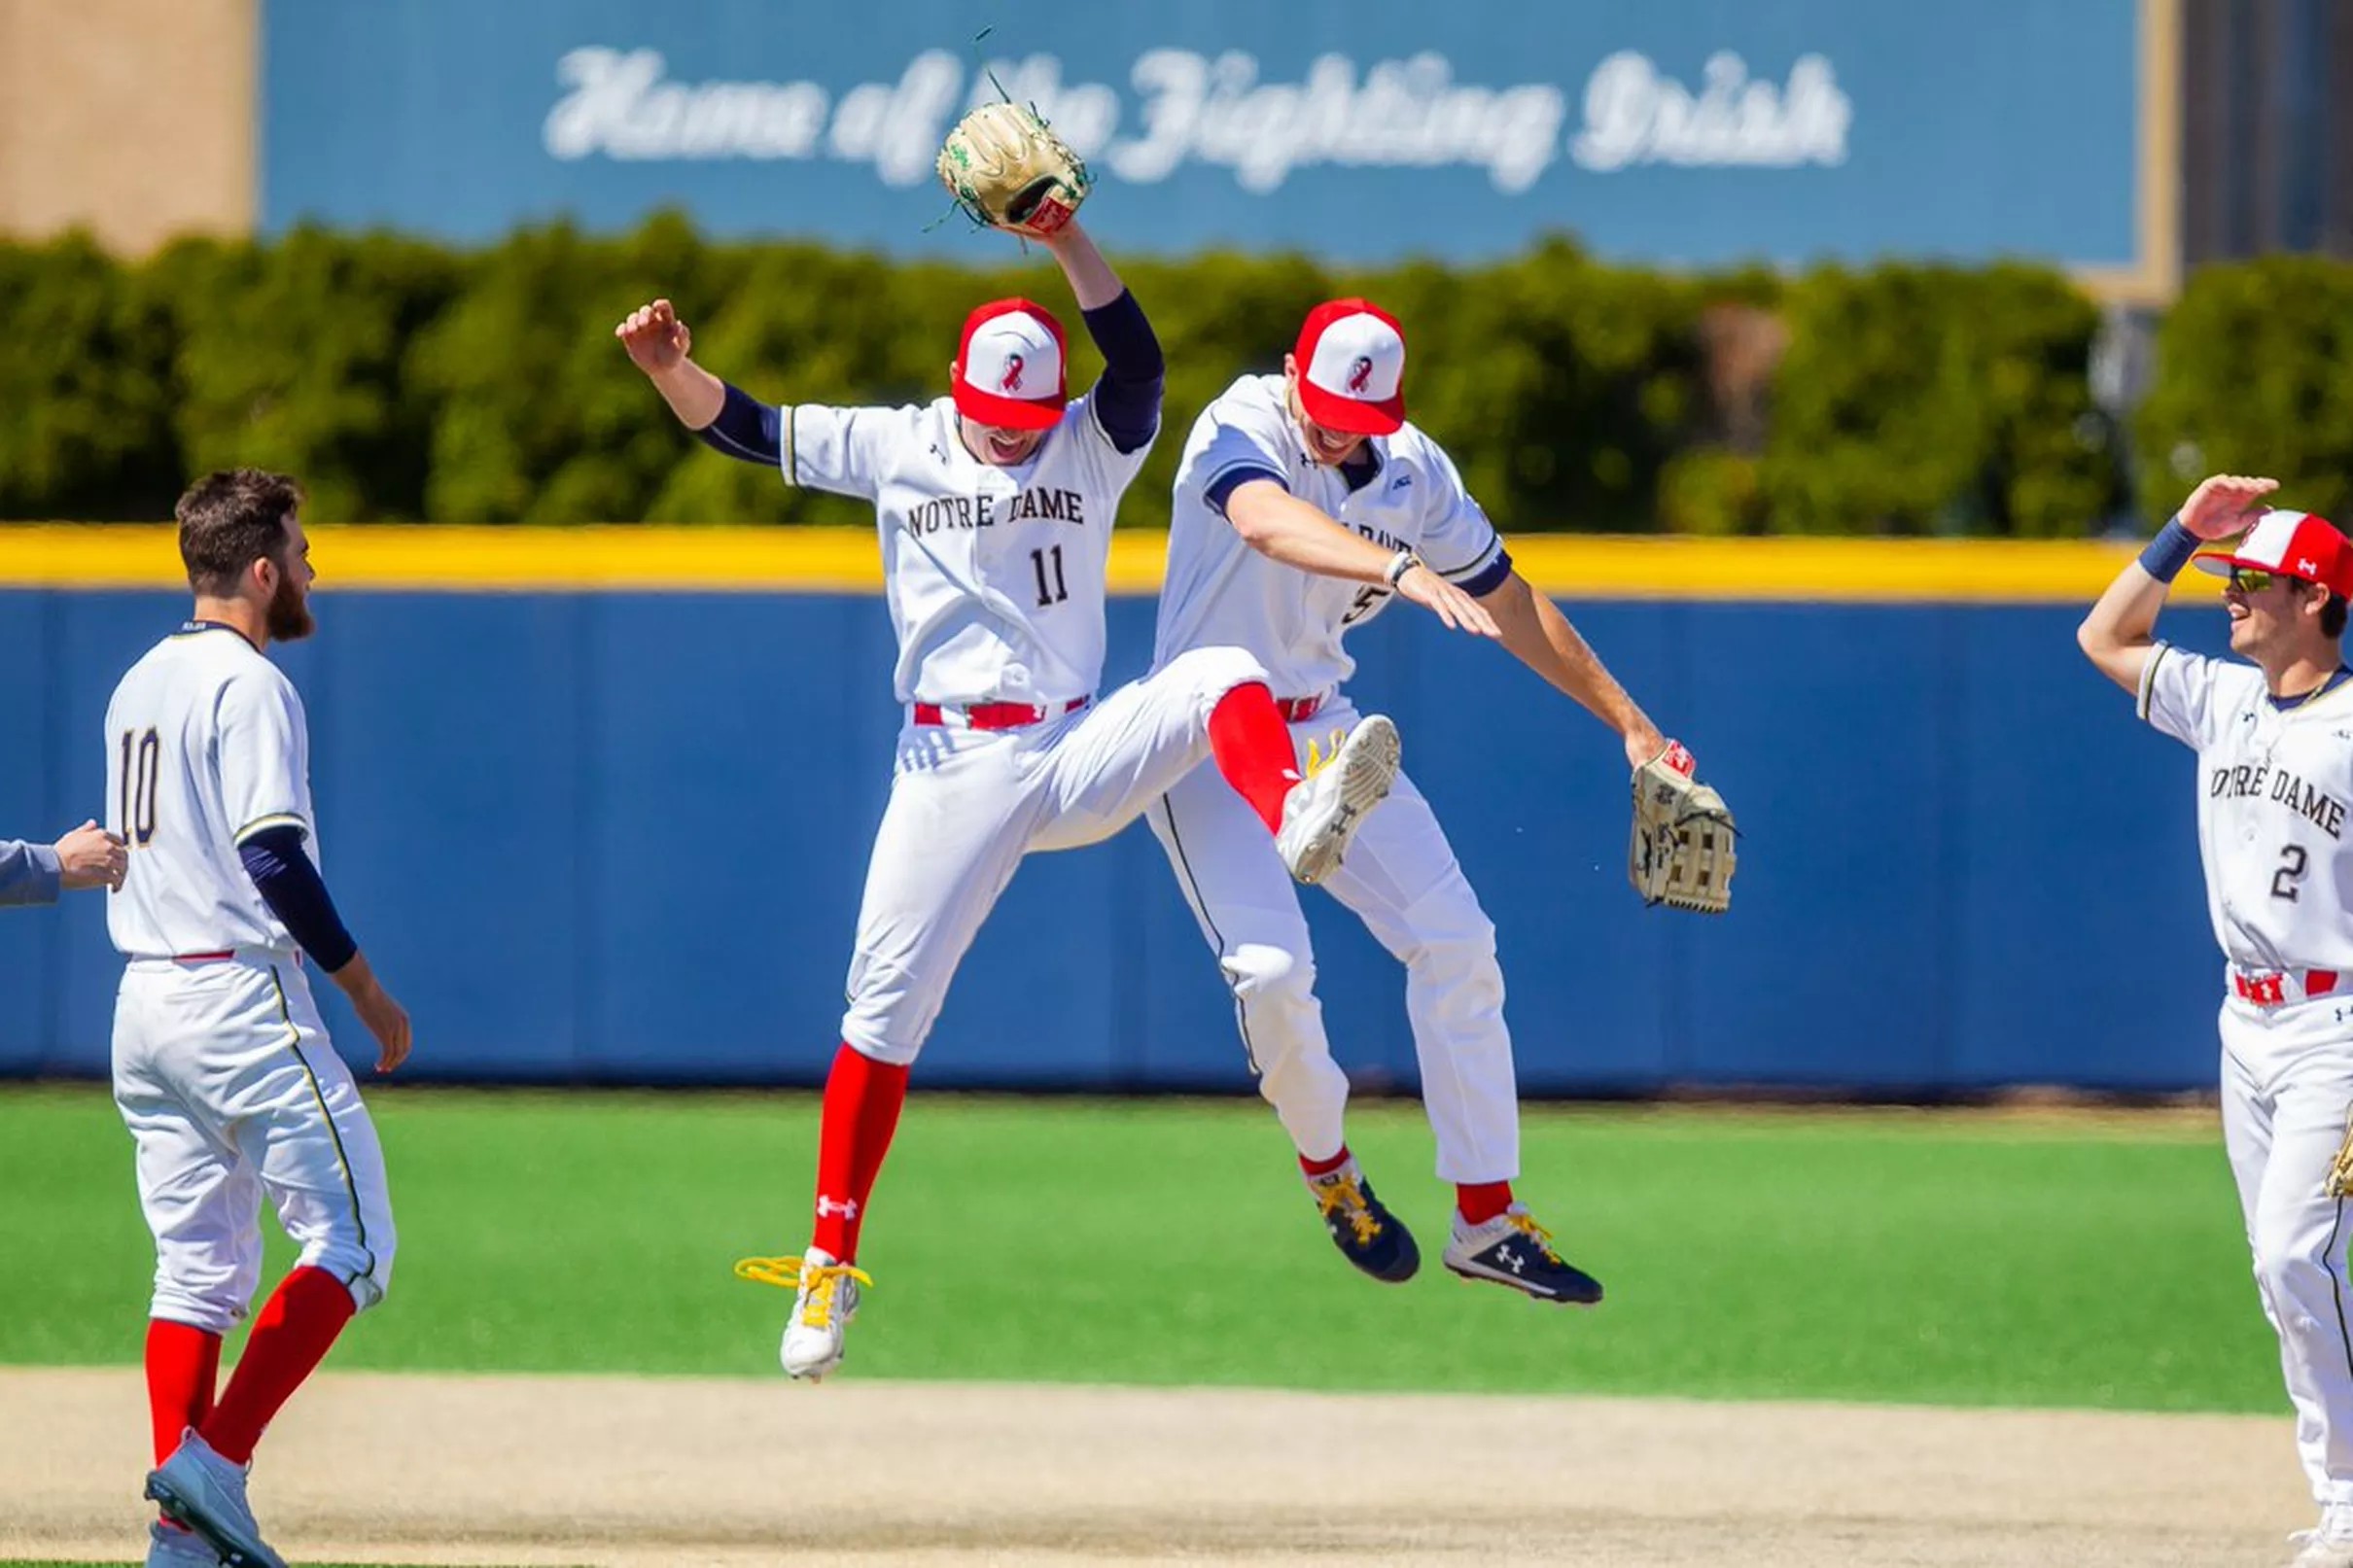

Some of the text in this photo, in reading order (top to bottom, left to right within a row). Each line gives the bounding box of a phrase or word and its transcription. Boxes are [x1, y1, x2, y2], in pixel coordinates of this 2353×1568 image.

[544, 45, 828, 161] Home
[828, 49, 965, 185] of
[1106, 47, 1566, 192] Fighting
[1569, 49, 1853, 173] Irish
[908, 494, 994, 538] NOTRE
[1030, 542, 1068, 608] 11
[1341, 584, 1390, 624] 5
[122, 727, 159, 846] 10
[2270, 769, 2346, 841] DAME
[2270, 843, 2307, 903] 2
